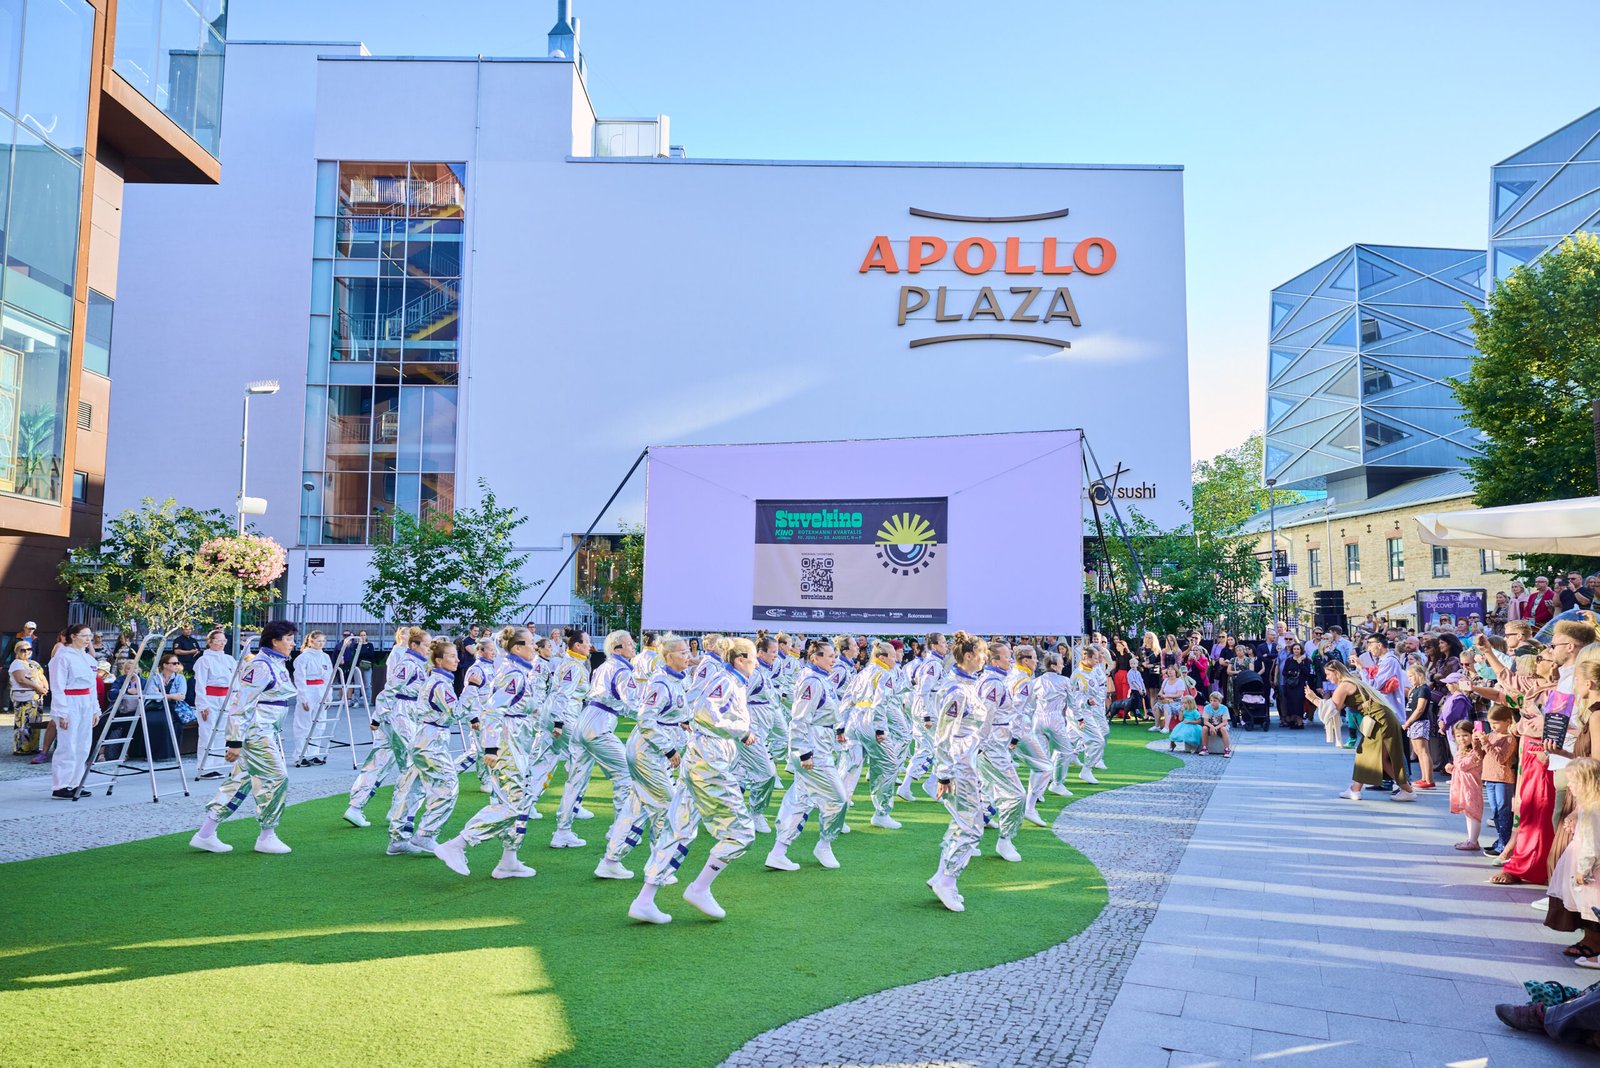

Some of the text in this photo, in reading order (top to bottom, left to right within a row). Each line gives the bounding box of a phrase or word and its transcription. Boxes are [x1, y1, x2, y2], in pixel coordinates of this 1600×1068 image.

[859, 236, 1117, 275] APOLLO
[898, 285, 1081, 326] PLAZA
[1117, 481, 1156, 499] sushi
[775, 508, 863, 528] Suvekino
